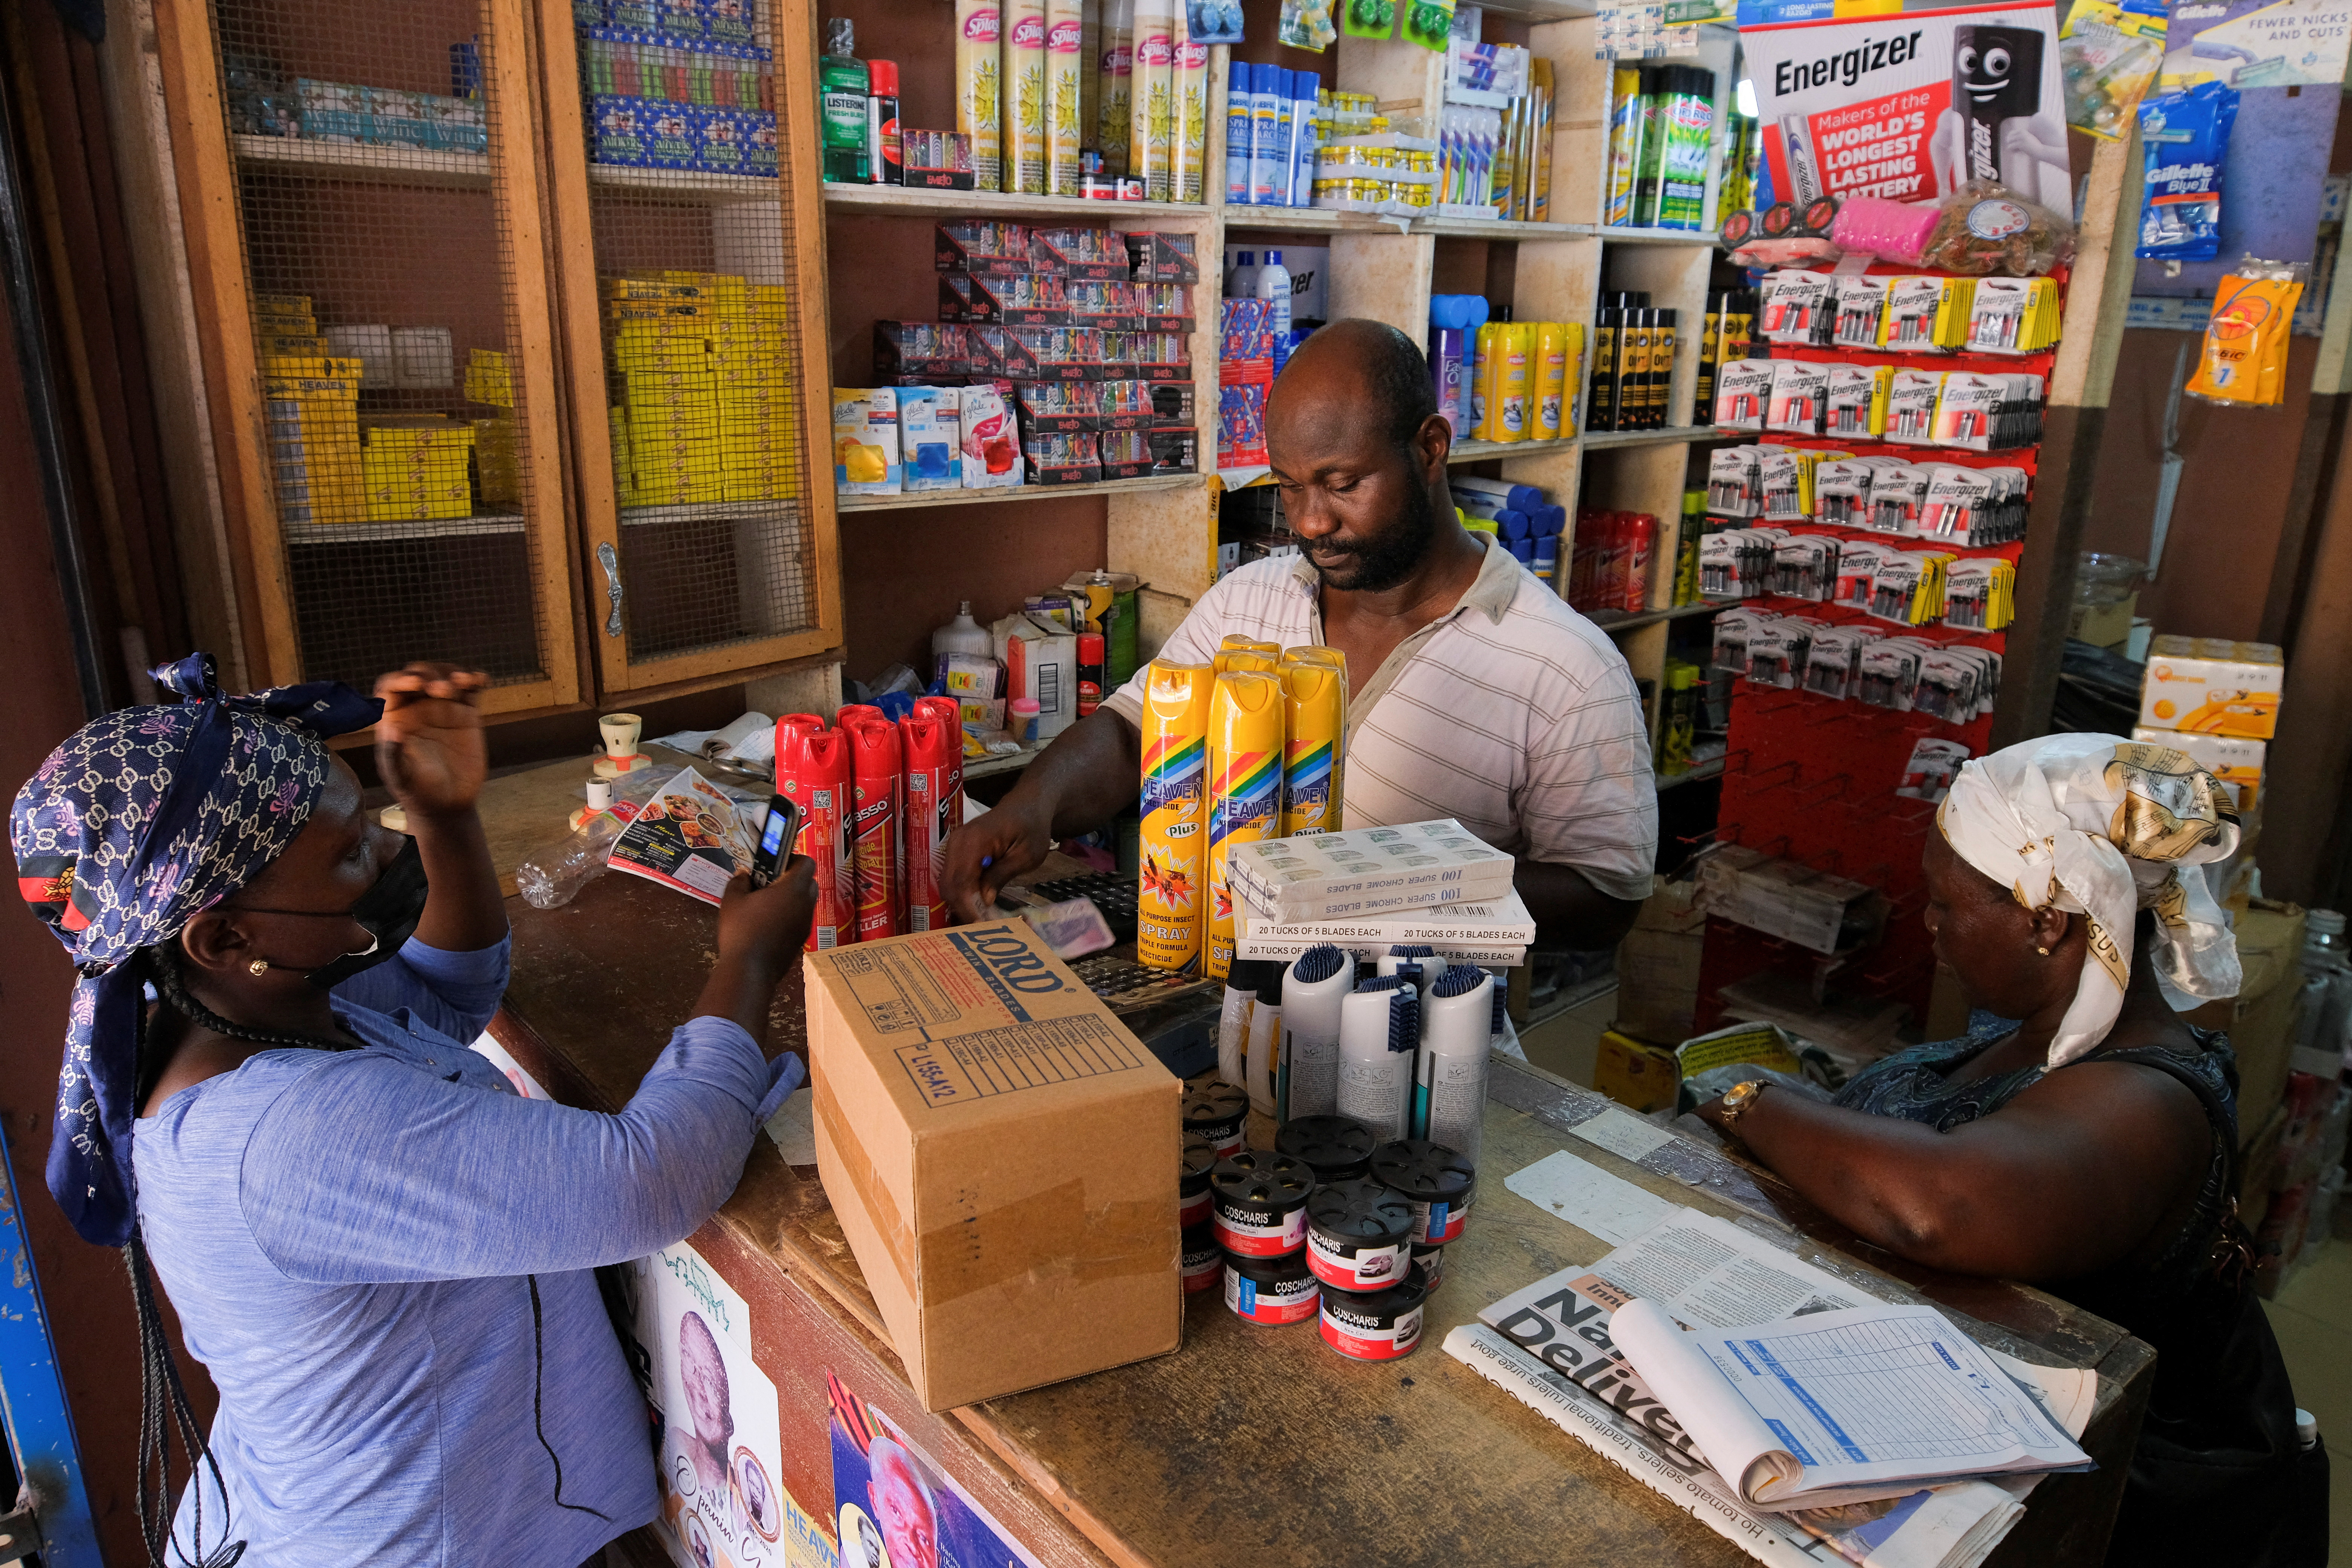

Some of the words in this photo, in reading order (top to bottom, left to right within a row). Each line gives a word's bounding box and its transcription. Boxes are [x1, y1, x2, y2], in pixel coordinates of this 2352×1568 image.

[2176, 5, 2227, 20] Gillette
[2249, 17, 2297, 29] FEWER
[2303, 13, 2348, 25] NICKS
[2269, 30, 2301, 40] AND
[2308, 26, 2344, 38] CUTS
[1776, 29, 1923, 96] Energizer
[827, 98, 865, 110] LISTERINE
[1818, 109, 1875, 130] Makers
[1878, 99, 1897, 115] of
[1900, 92, 1930, 111] the
[306, 110, 361, 133] Wind
[1821, 110, 1925, 151] WORLD'S
[1826, 133, 1922, 170] LONGEST
[927, 173, 952, 186] EMEJO
[1830, 156, 1917, 190] LASTING
[2147, 163, 2214, 183] Gillette
[2167, 179, 2198, 191] Blue
[1158, 261, 1181, 274] EMEJO
[1776, 283, 1827, 297] Energizer
[1843, 290, 1886, 302] Energizer
[1894, 289, 1940, 307] Energizer
[1977, 292, 2026, 306] Energizer
[621, 309, 658, 318] HEAVEN
[2219, 350, 2246, 361] BIC
[1061, 367, 1083, 378] EMEJO
[1723, 372, 1771, 387] Energizer
[299, 381, 346, 390] HEAVEN
[1776, 374, 1826, 389] Energizer
[1831, 381, 1873, 396] Energizer
[1893, 386, 1939, 400] Energizer
[1946, 387, 2005, 403] Energizer
[906, 402, 925, 421] glade
[967, 401, 987, 419] glade
[1058, 419, 1080, 430] EMEJO
[1712, 462, 1743, 471] Energizer
[1764, 464, 1796, 482] Energizer
[1062, 470, 1082, 481] EMEJO
[1819, 473, 1854, 485] Energizer
[1873, 481, 1909, 492] Energizer
[1931, 482, 1988, 498] Energizer
[1841, 556, 1879, 569] Energiz
[1877, 567, 1920, 580] Energizer
[1947, 576, 1990, 588] Energizer
[1142, 777, 1203, 800] HEAVEN
[1285, 785, 1330, 804] AVEN
[853, 800, 888, 823] asso
[1142, 797, 1180, 811] INSECTICIDE
[1217, 794, 1280, 818] HEAVEN
[654, 825, 675, 836] Menu
[1168, 823, 1198, 837] Plus
[1217, 818, 1262, 830] INSECTICIDE
[1408, 874, 1436, 884] SUPER
[1442, 870, 1462, 881] 100
[1327, 882, 1362, 893] BLADES
[1366, 879, 1404, 890] CHROME
[1407, 892, 1436, 902] SUPER
[1441, 887, 1461, 900] 100
[1326, 902, 1361, 913] BLADES
[1366, 897, 1403, 908] CHROME
[1148, 911, 1173, 921] PURPOSE
[1174, 914, 1195, 923] INSECT
[1140, 920, 1192, 941] SPRAY
[1259, 926, 1269, 935] 20
[1271, 926, 1295, 935] TUCKS
[1297, 927, 1312, 936] OF
[1315, 927, 1320, 936] 5
[1322, 927, 1356, 936] BLADES
[1358, 928, 1381, 937] EACH
[1404, 929, 1414, 938] 20
[1416, 929, 1443, 939] TUCKS
[1446, 930, 1458, 939] OF
[1466, 931, 1500, 939] BLADES
[1502, 931, 1525, 940] EACH
[1140, 936, 1156, 947] TRIPLE
[1157, 943, 1188, 951] FORMULA
[1249, 946, 1259, 955] 20
[1261, 946, 1287, 955] TUCKS
[1289, 946, 1302, 955] OF
[962, 925, 1064, 993] LORD
[1140, 947, 1173, 963] INSECTICIDE
[1448, 951, 1453, 960] 5
[1455, 951, 1488, 960] BLADES
[1490, 952, 1514, 961] EACH
[936, 934, 980, 982] DISPOSABLE
[983, 989, 1016, 1025] RAZORS
[962, 947, 982, 967] TWIN
[985, 977, 1021, 1012] BLADES
[911, 1054, 957, 1098] L155-A12
[1225, 1205, 1268, 1224] COSCHARIS
[1309, 1226, 1341, 1253] COSCHARIS
[1276, 1274, 1316, 1293] COSCHARIS
[1334, 1305, 1379, 1327] COSCHARIS
[1470, 1338, 1496, 1360] govt
[1498, 1357, 1526, 1381] urge
[1713, 1355, 1742, 1382] 0000538
[1496, 1306, 1704, 1464] Delive
[1528, 1376, 1562, 1404] rulers
[1792, 1385, 1809, 1401] GOODS
[1563, 1398, 1632, 1451] traditional
[1812, 1406, 1842, 1437] DESCRIPTION
[1850, 1449, 1863, 1461] QTY
[1637, 1447, 1686, 1484] sellers,
[1687, 1483, 1739, 1522] tomato
[1741, 1519, 1767, 1540] Ho
[747, 1522, 772, 1557] 1945-2020
